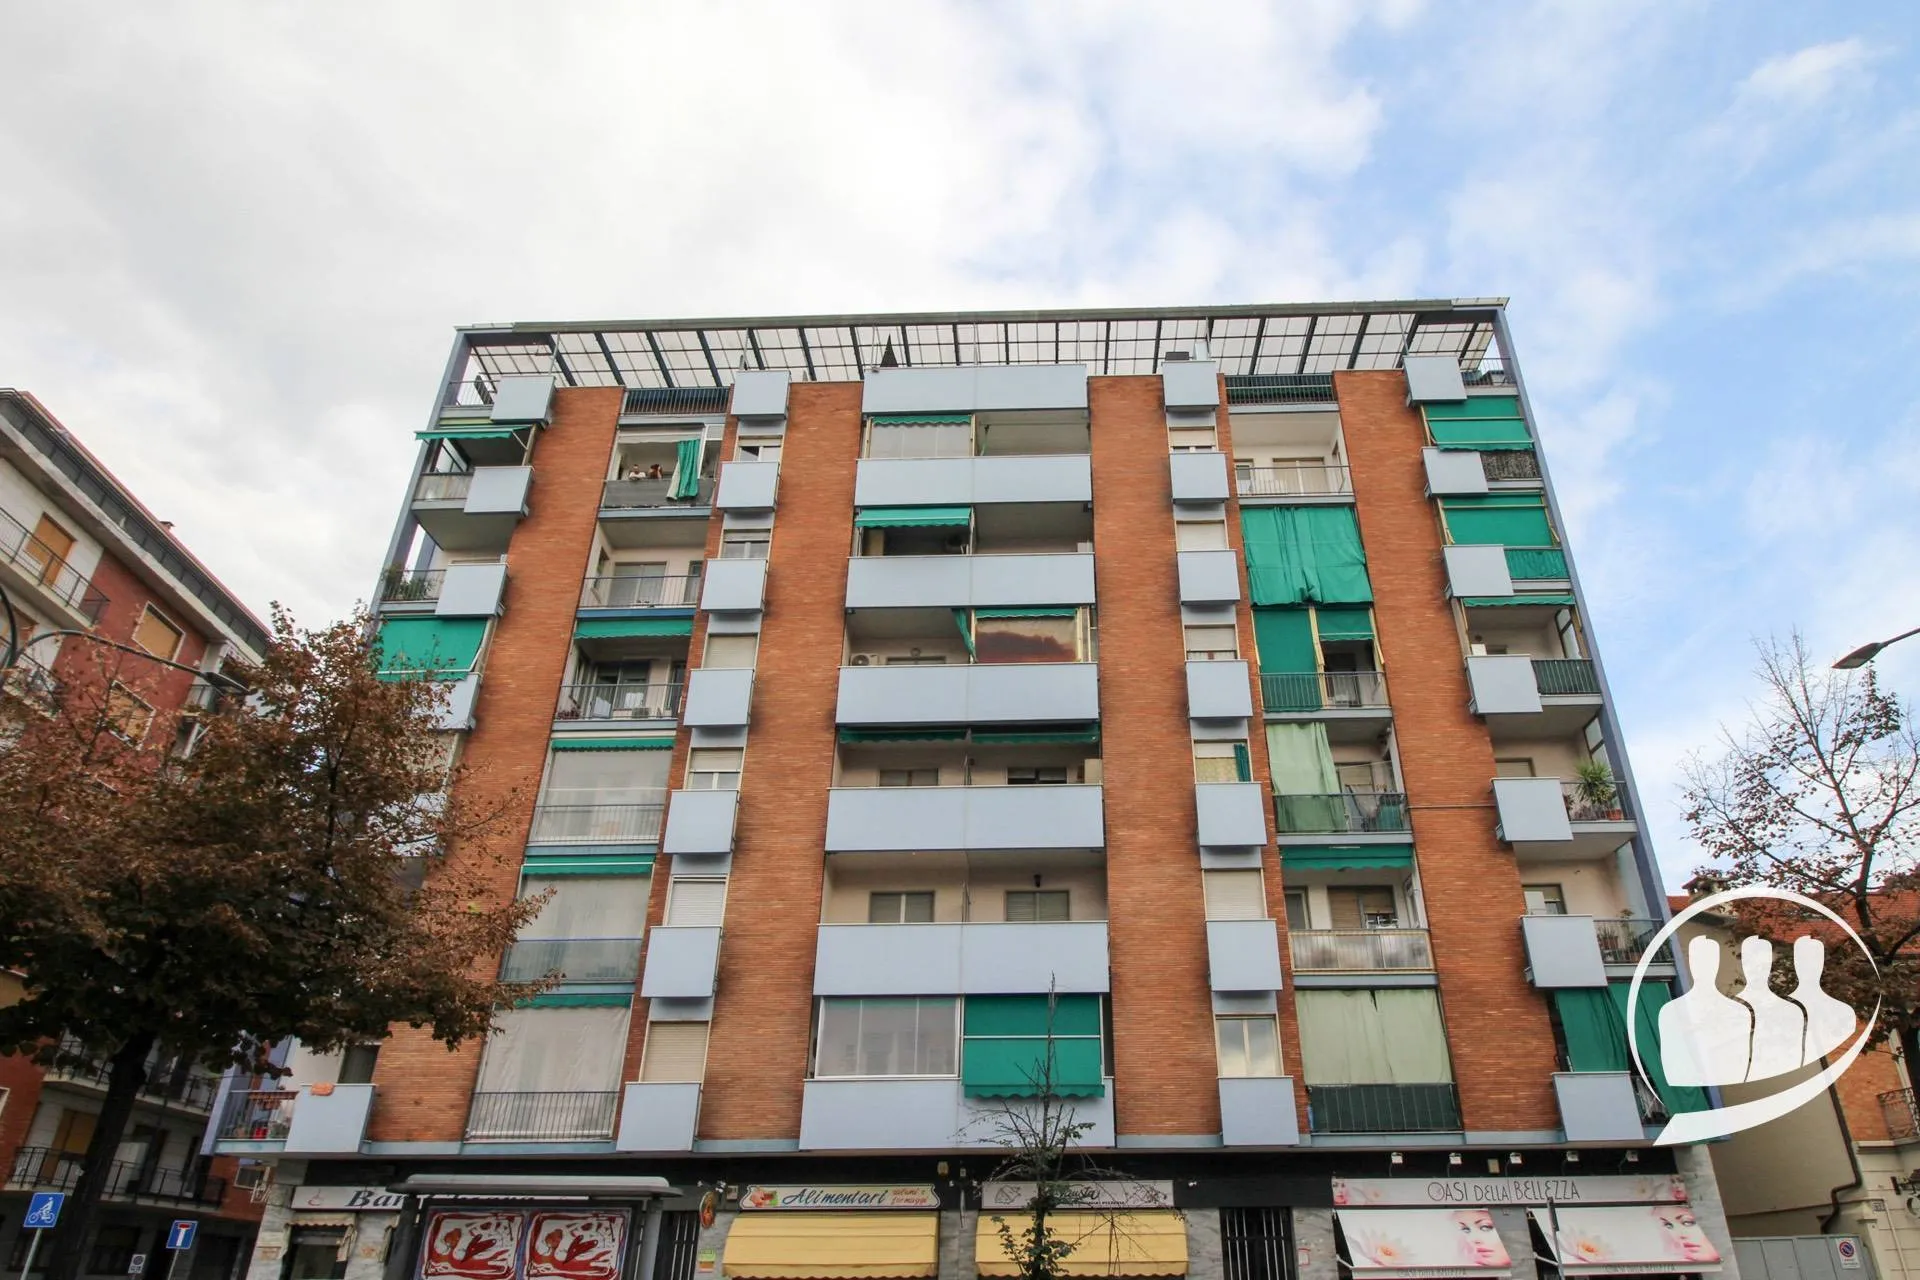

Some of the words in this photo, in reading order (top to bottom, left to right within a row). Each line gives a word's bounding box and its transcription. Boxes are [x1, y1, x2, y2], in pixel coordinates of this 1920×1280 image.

[345, 1189, 408, 1207] Bar
[782, 1188, 888, 1205] Alimentari
[1428, 1181, 1468, 1201] OASI
[1473, 1184, 1510, 1201] DELLA
[1513, 1180, 1580, 1201] BELLEZZA
